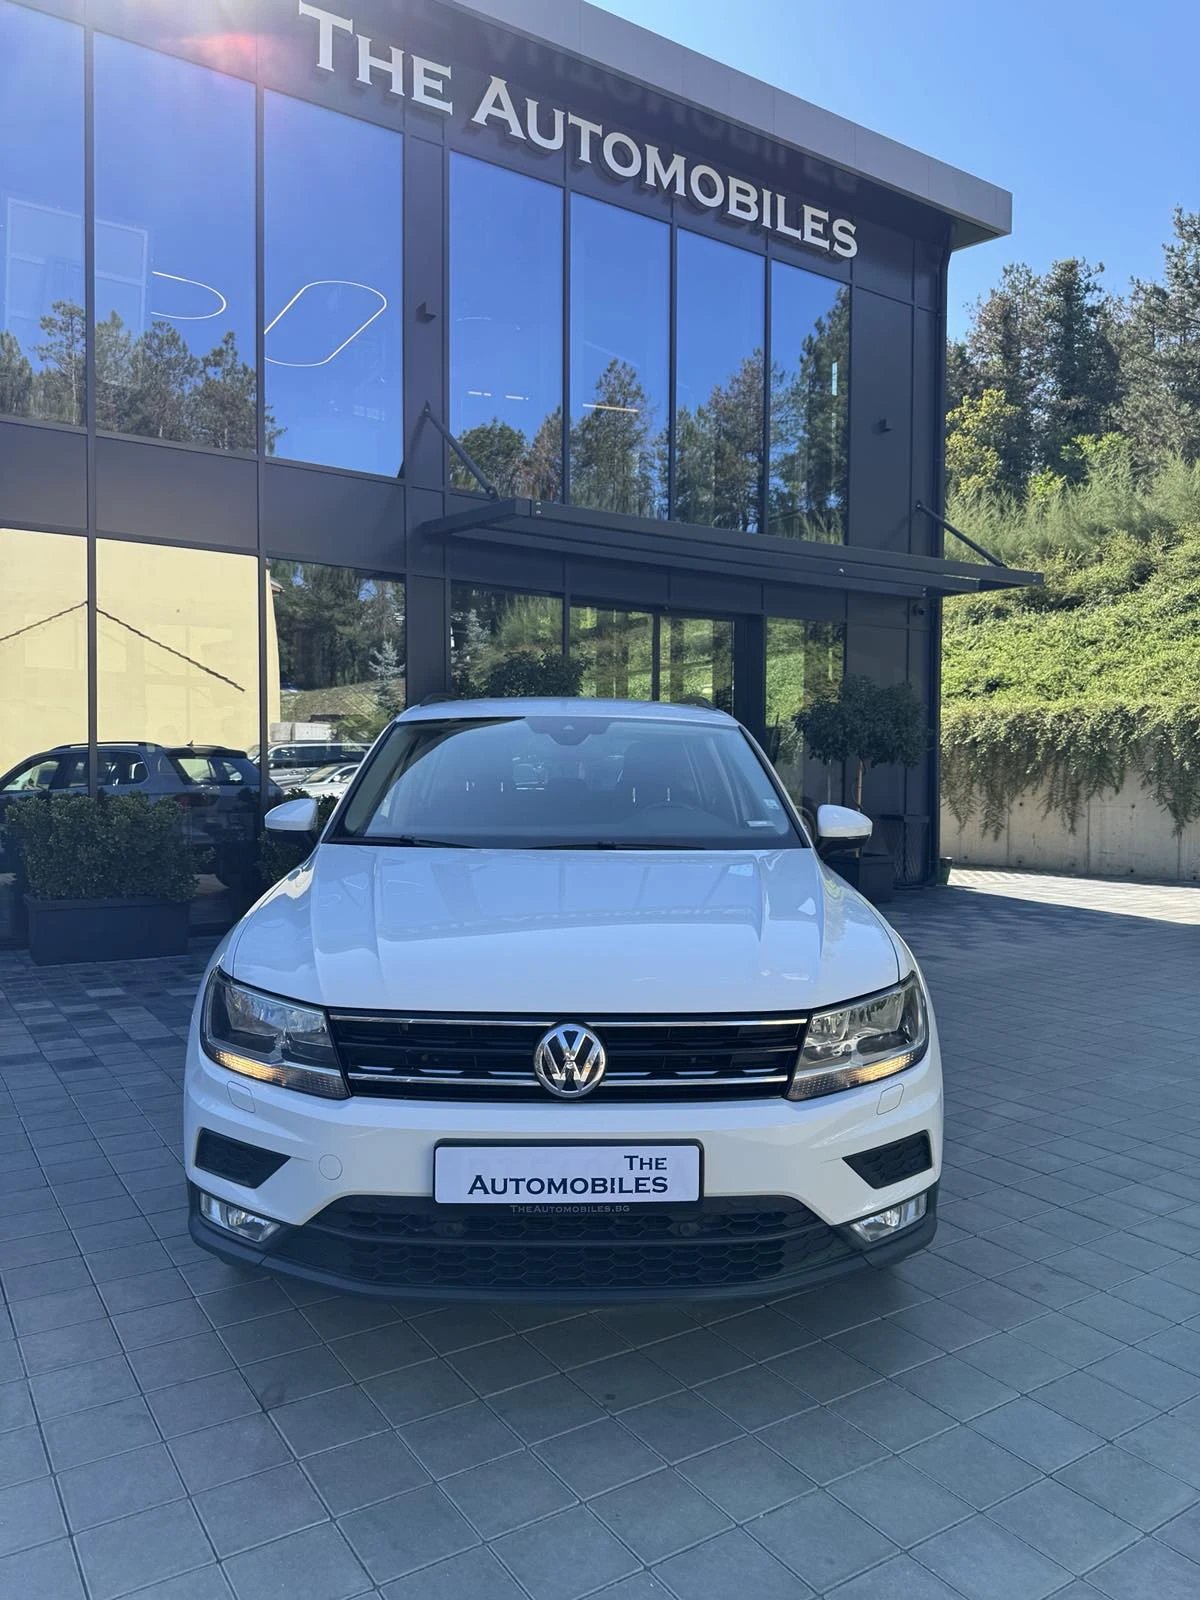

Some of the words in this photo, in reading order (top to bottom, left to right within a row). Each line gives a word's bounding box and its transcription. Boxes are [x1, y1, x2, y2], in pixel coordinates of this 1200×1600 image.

[298, 0, 453, 115] THE
[471, 75, 859, 259] AUTOMOBILES
[534, 1023, 606, 1098] VW
[467, 1175, 668, 1195] AUTOMOBILES
[624, 1155, 667, 1171] THE
